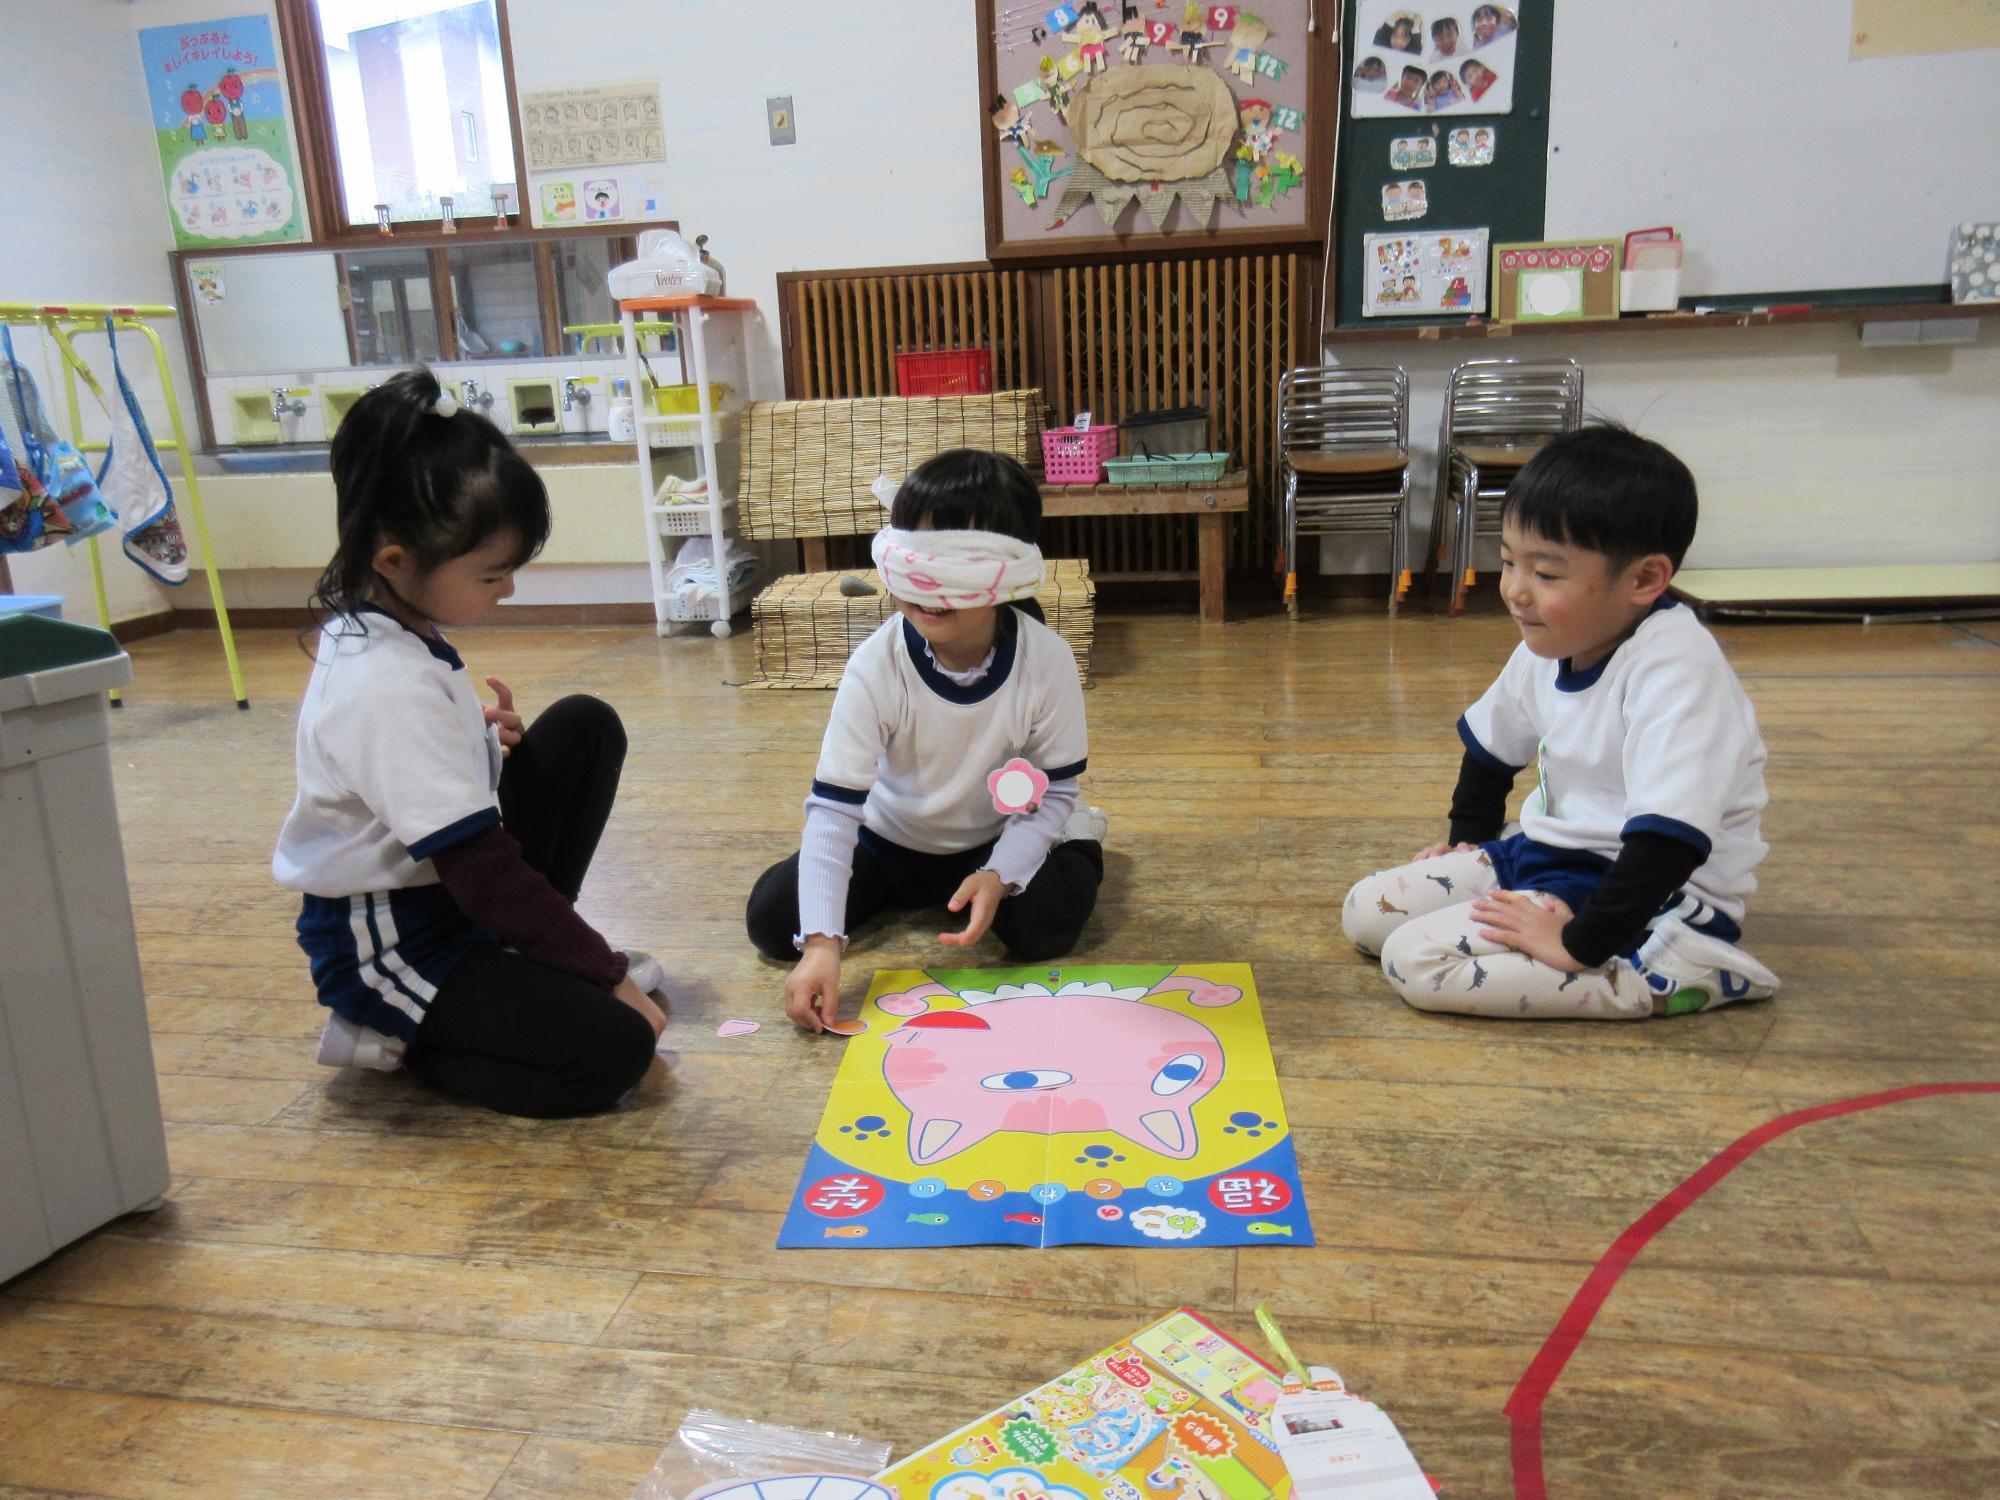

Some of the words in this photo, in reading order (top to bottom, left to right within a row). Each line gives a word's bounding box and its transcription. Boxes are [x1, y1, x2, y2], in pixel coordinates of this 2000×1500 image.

[1055, 8, 1070, 25] 8
[1214, 8, 1228, 28] 9
[1153, 23, 1167, 42] 9
[1258, 54, 1279, 78] 12
[1276, 108, 1298, 128] 12
[811, 1178, 869, 1210] 笑
[1218, 1178, 1281, 1209] 福
